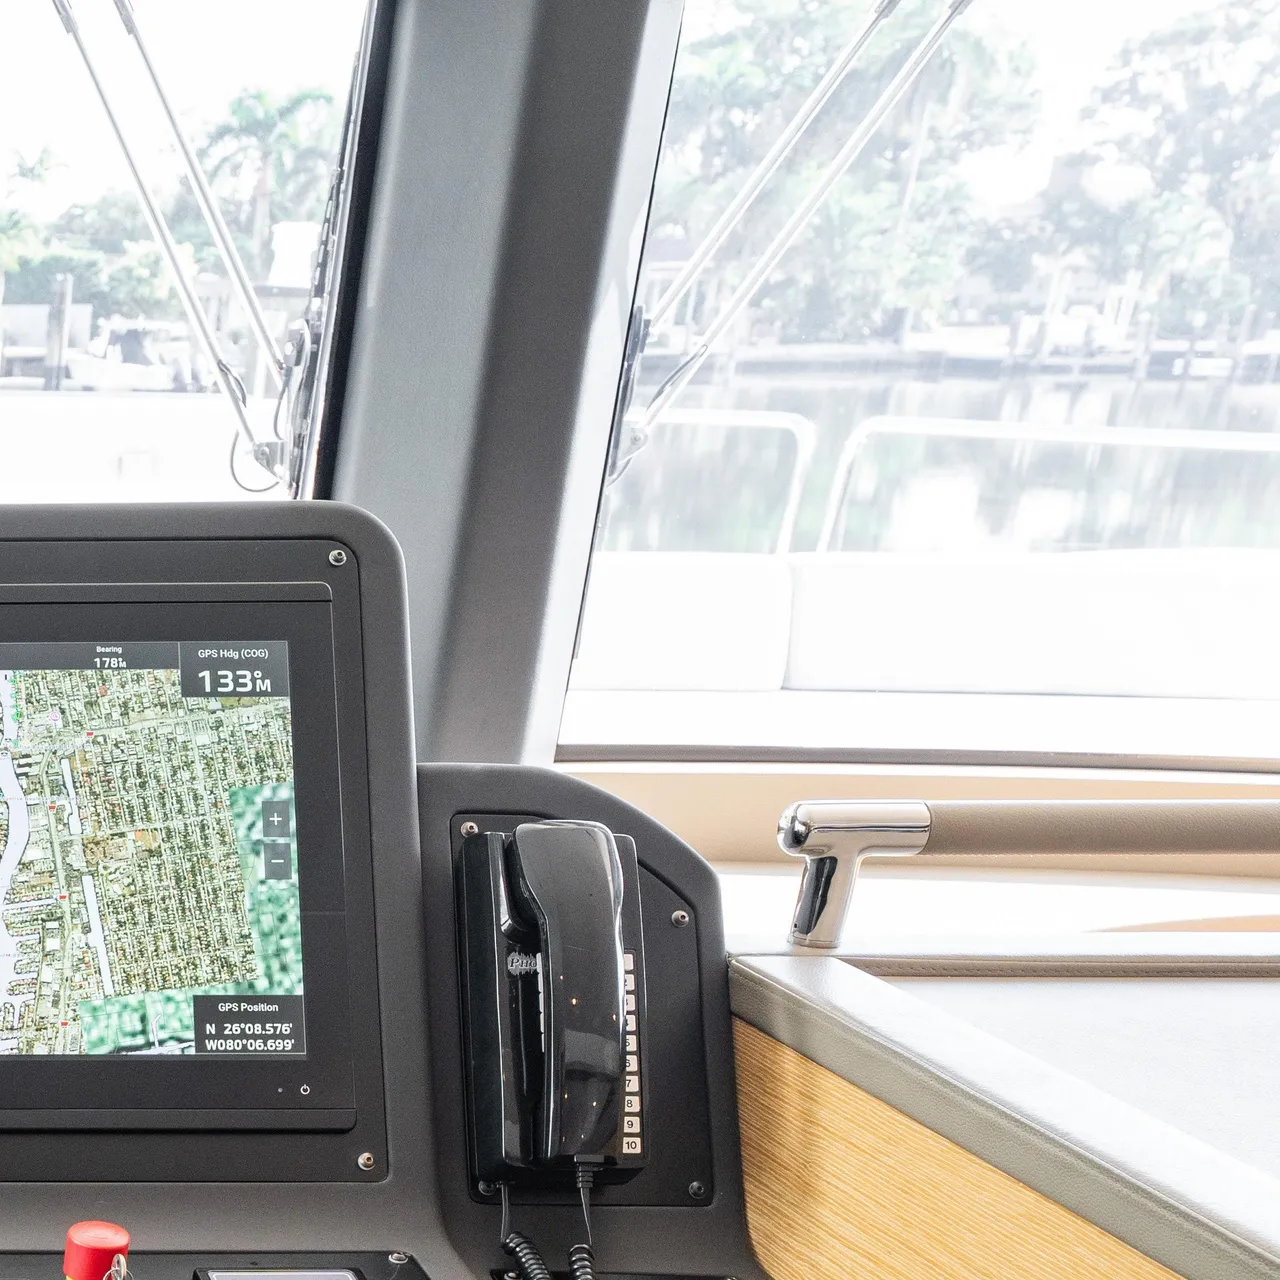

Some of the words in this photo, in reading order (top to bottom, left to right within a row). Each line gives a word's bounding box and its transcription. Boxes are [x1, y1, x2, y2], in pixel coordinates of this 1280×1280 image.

[96, 646, 122, 654] Bearing
[198, 649, 218, 659] GPS
[220, 648, 238, 660] Hdg
[241, 648, 269, 660] (COG)
[218, 1003, 238, 1012] GPS
[240, 1003, 279, 1013] Position
[205, 1023, 216, 1034] N
[626, 1099, 633, 1108] 8
[626, 1120, 634, 1128] 9
[625, 1140, 637, 1150] 10
